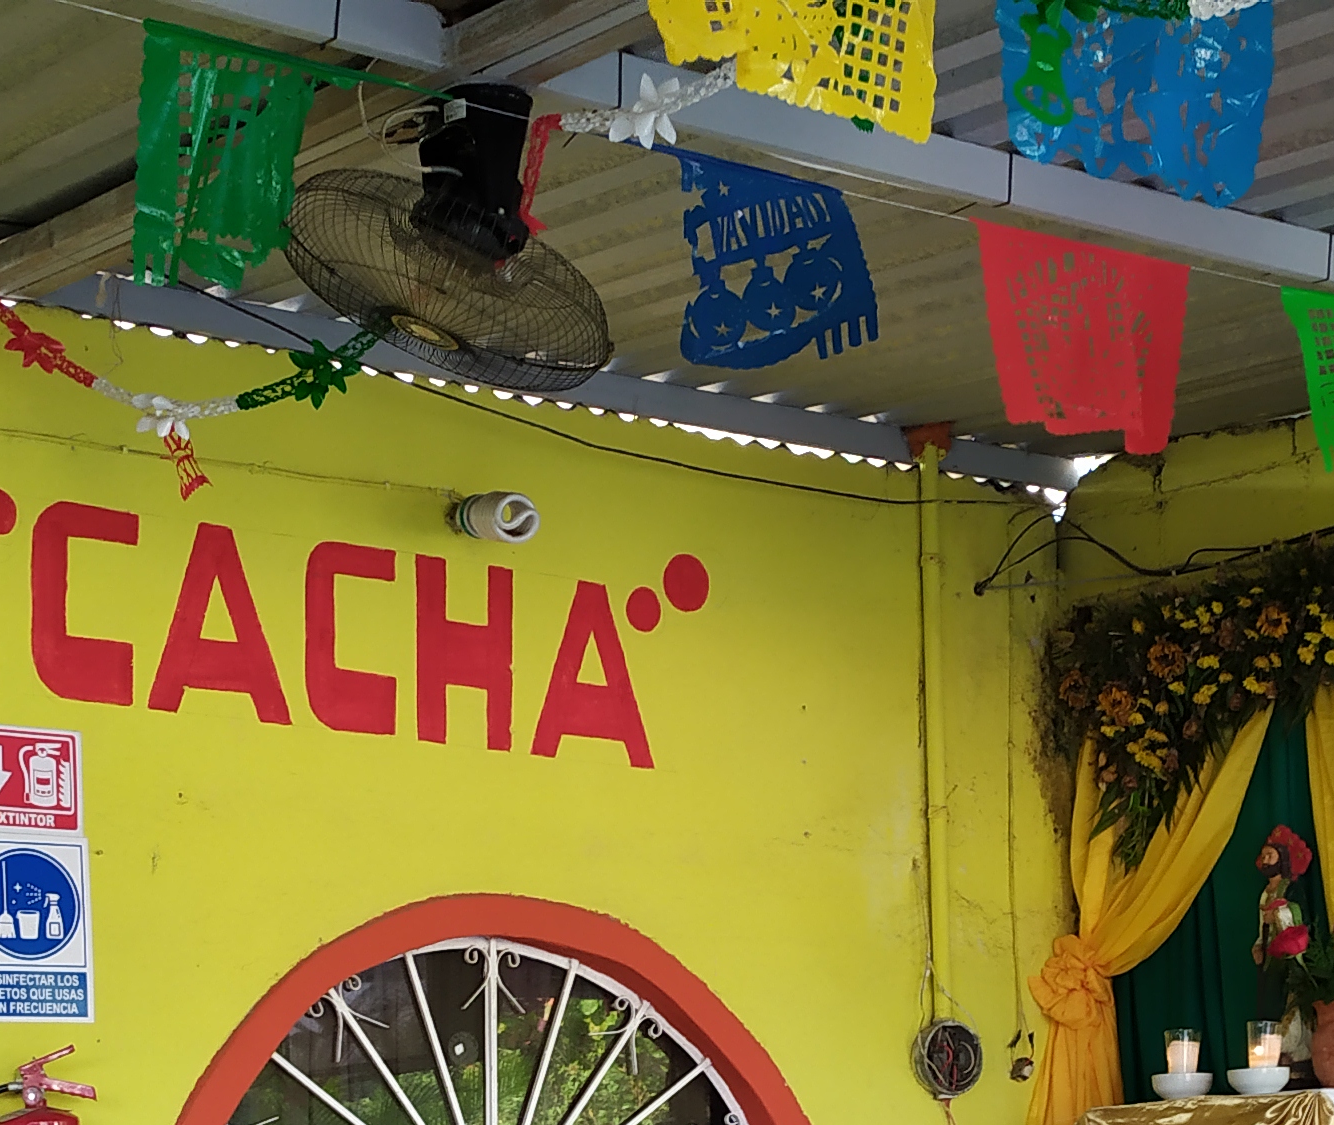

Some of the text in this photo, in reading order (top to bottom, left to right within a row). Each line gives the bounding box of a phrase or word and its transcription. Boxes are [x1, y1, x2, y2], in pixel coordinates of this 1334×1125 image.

[57, 974, 79, 987] LOS
[30, 988, 54, 1001] QUE
[55, 988, 84, 1001] USAS
[9, 1002, 79, 1015] FRECUENCIA
